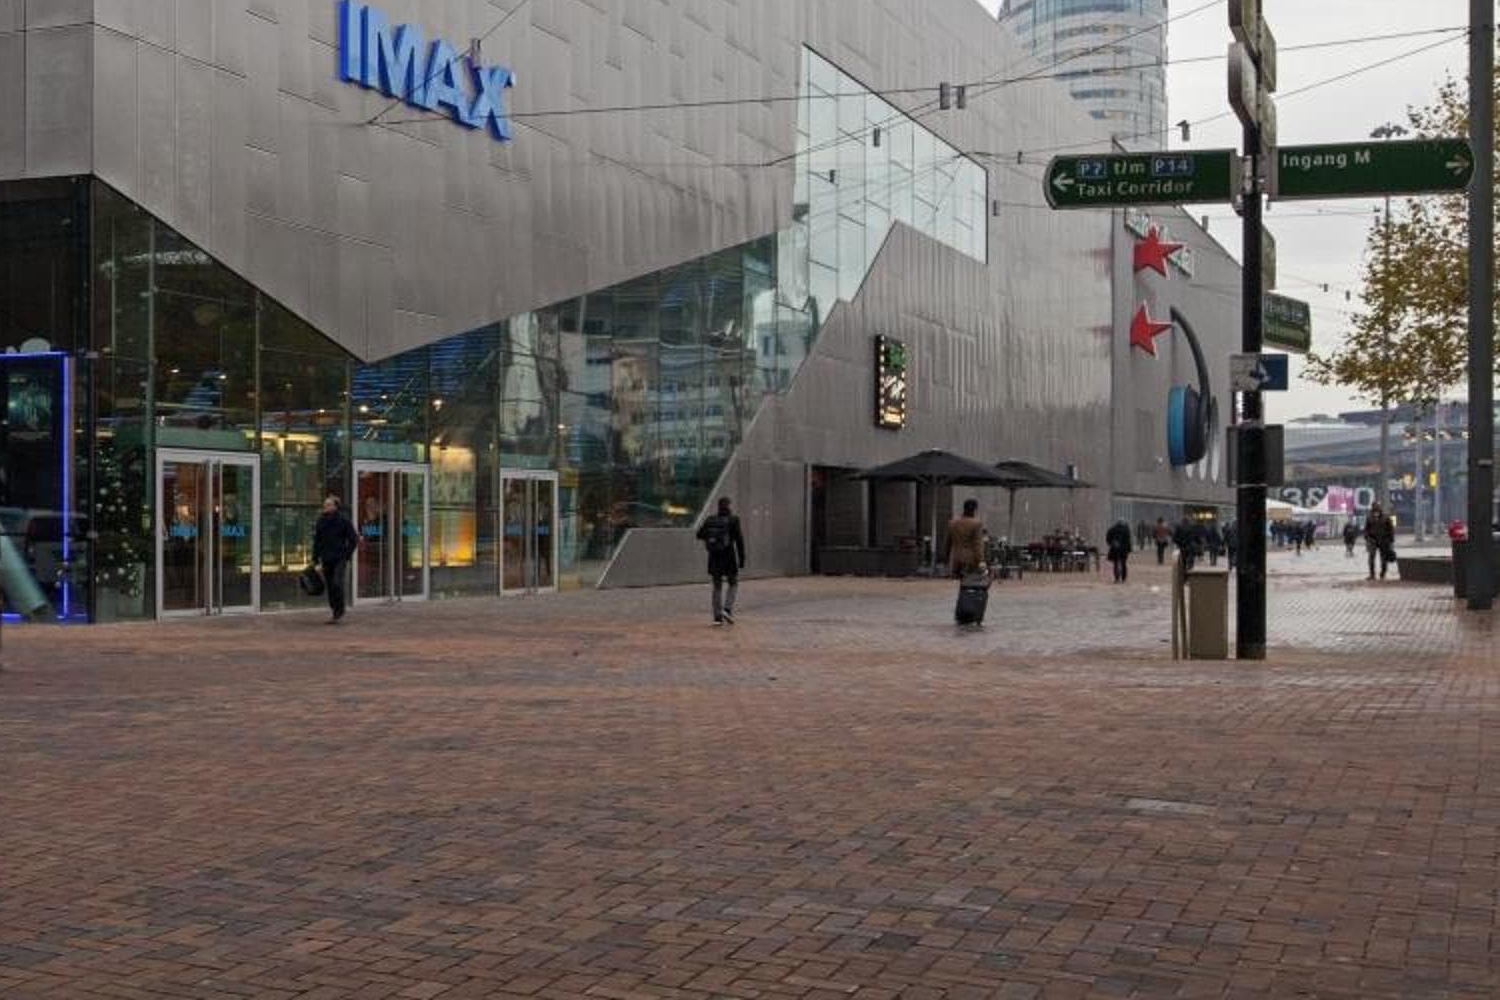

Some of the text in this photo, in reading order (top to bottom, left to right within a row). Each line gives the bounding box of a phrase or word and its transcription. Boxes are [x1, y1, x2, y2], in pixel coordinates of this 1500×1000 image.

[1113, 160, 1146, 176] t/m
[1282, 149, 1371, 171] Ingang M
[1077, 179, 1194, 197] Taxi Corridor
